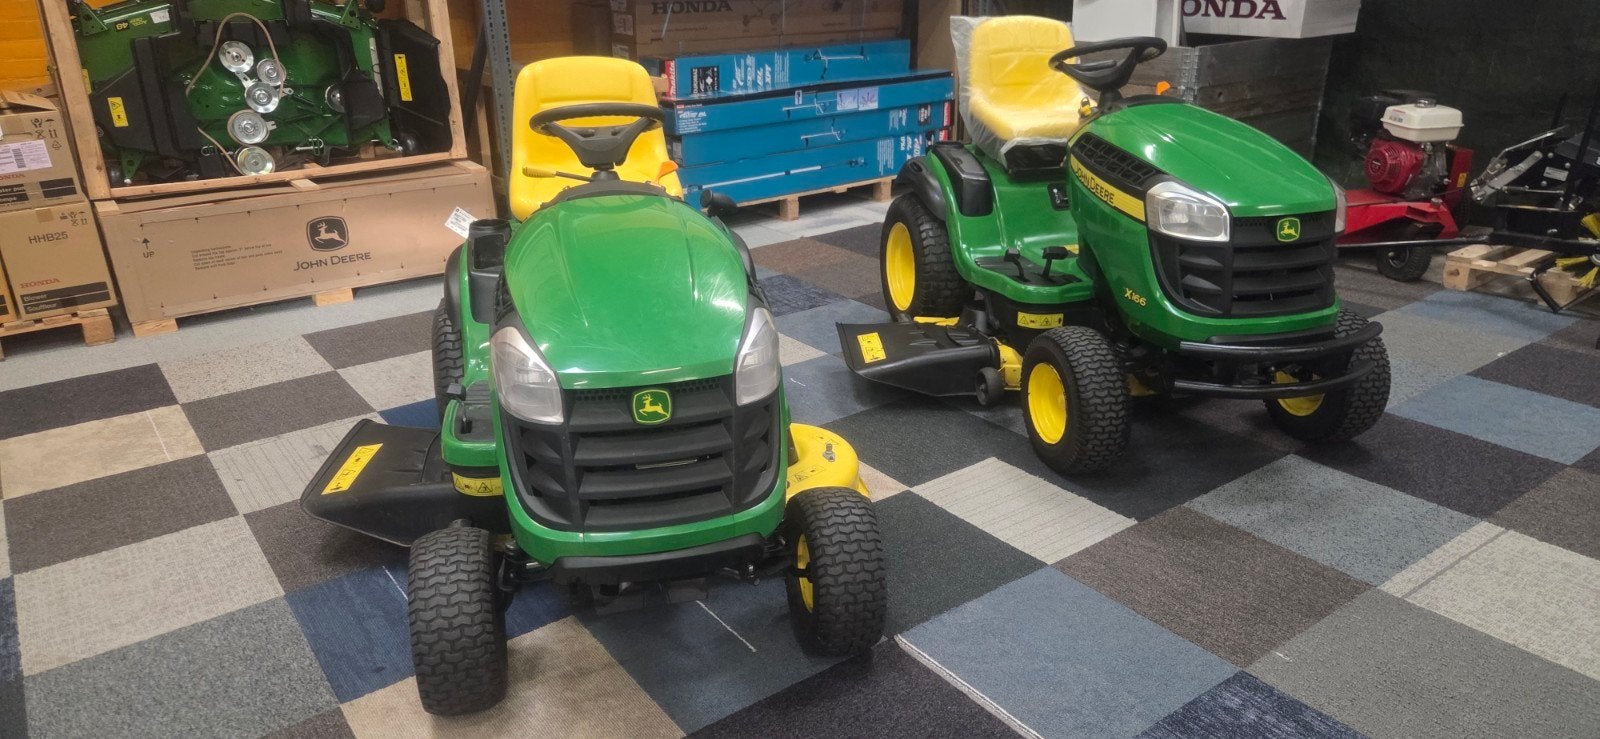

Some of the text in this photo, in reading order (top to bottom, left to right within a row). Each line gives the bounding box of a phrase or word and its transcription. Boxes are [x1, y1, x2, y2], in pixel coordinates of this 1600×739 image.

[651, 0, 734, 15] HONDA
[1181, 0, 1287, 20] ONDA
[1075, 162, 1115, 204] JOHN DEERE
[28, 231, 69, 244] HHB25
[142, 251, 155, 259] UP
[293, 258, 328, 272] JOHN
[330, 251, 372, 266] DEERE
[19, 278, 60, 289] HONDA
[1124, 287, 1147, 307] X166
